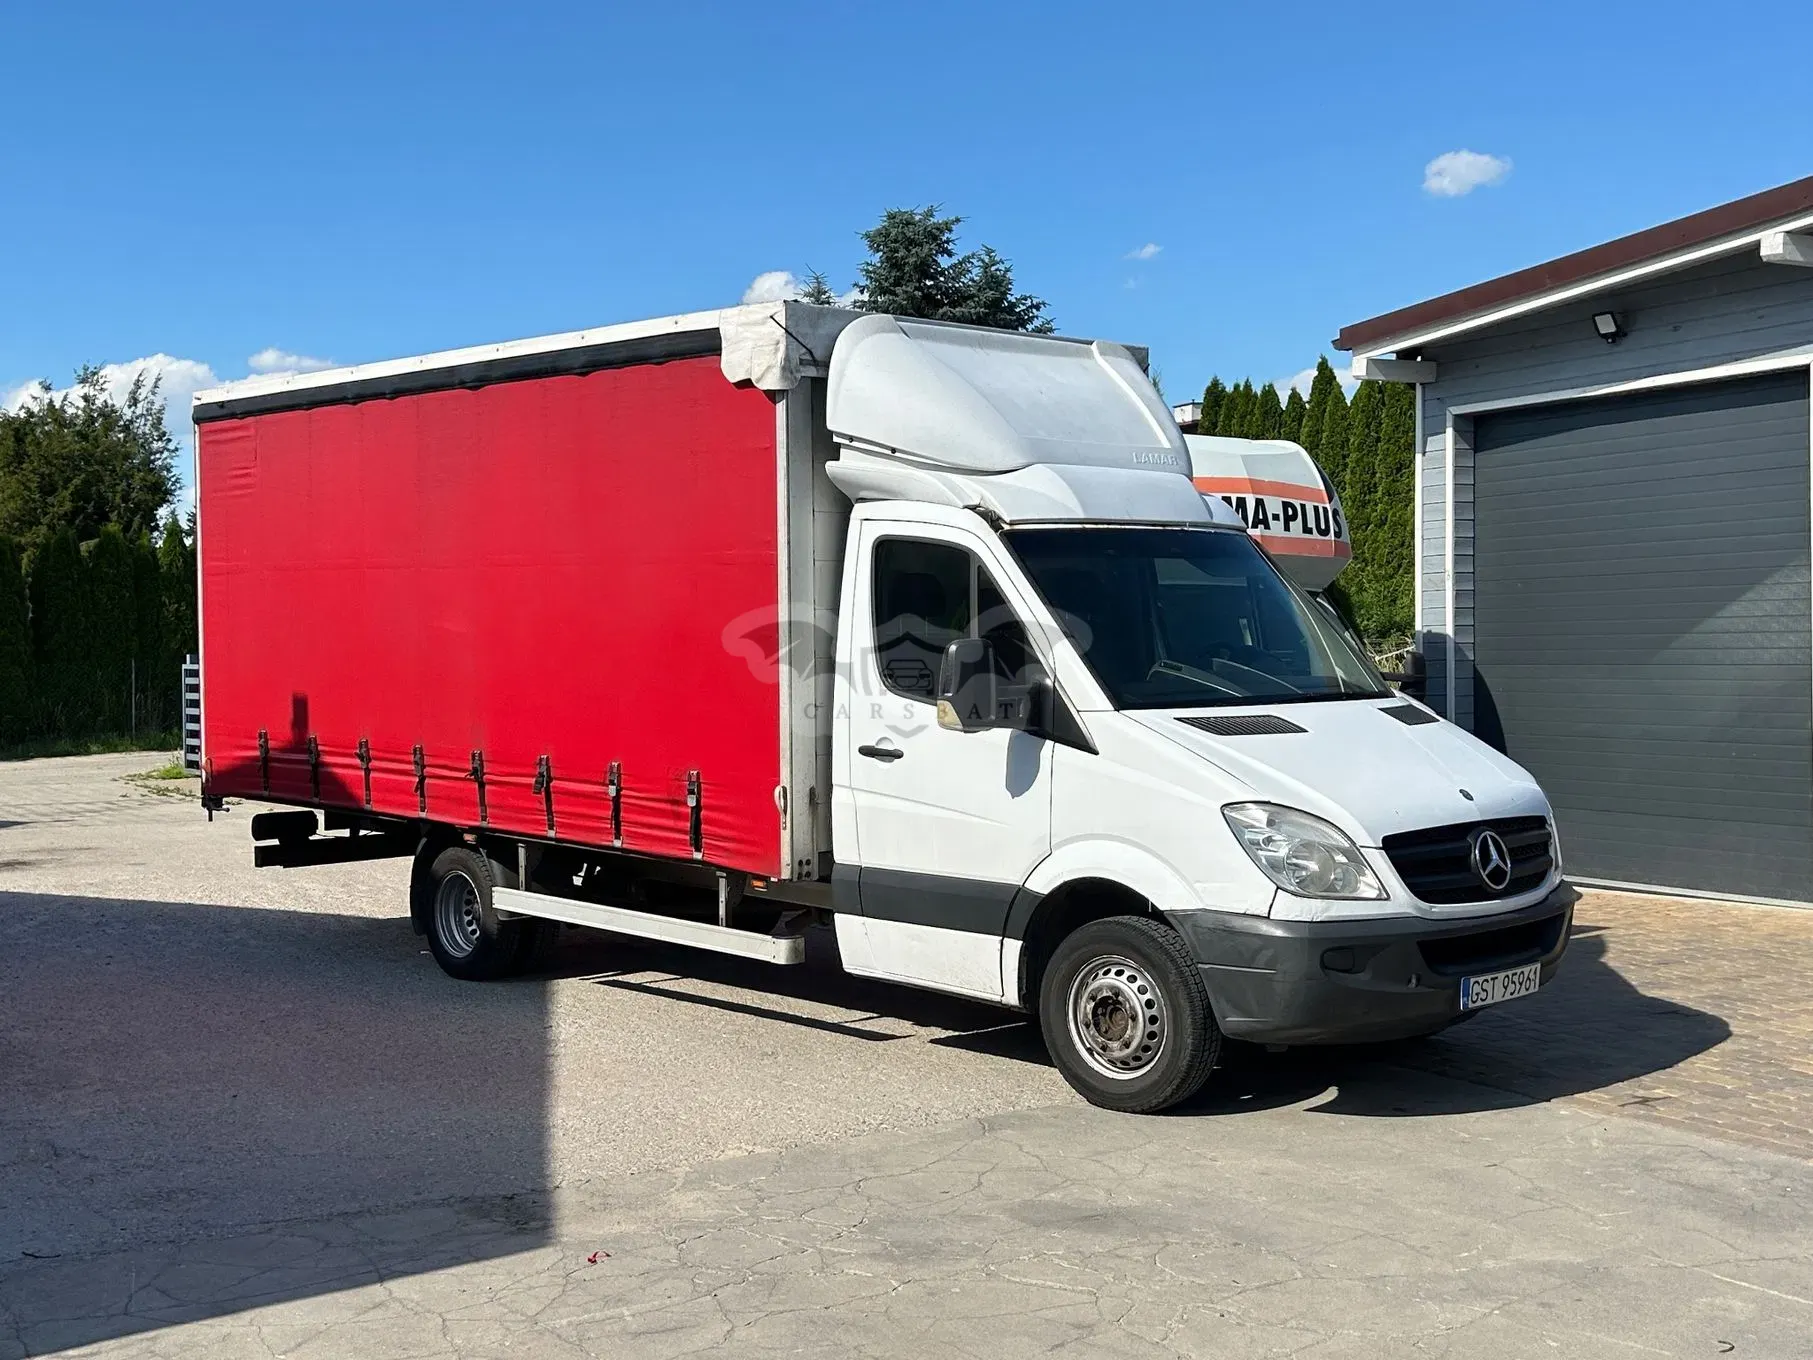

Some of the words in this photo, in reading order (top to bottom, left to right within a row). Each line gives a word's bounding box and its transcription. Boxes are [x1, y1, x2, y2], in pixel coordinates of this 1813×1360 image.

[1132, 452, 1179, 465] LAMAR
[1471, 977, 1498, 1004] GST
[1502, 967, 1538, 998] 95961
